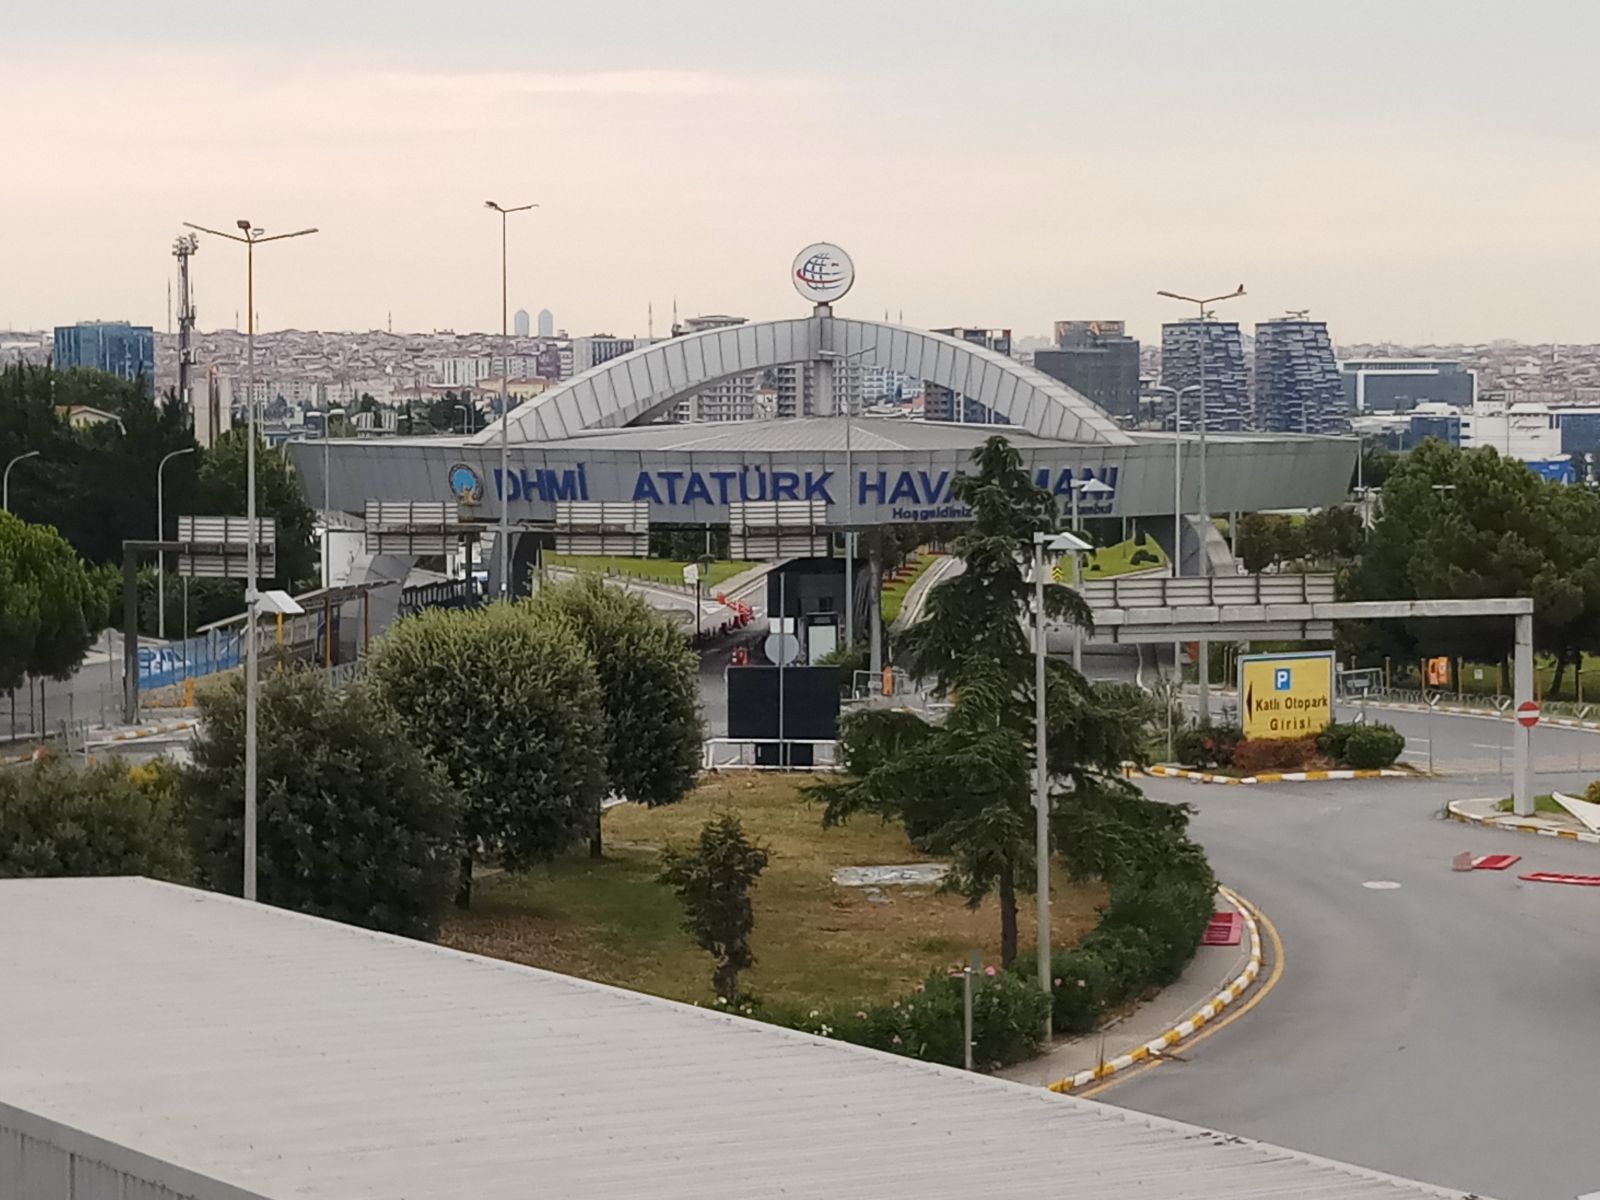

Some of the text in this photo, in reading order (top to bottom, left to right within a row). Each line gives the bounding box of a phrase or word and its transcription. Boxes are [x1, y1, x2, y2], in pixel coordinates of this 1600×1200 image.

[493, 463, 1118, 505] DHMİ ATATÜRK HAVANI
[1277, 670, 1288, 689] P
[1284, 696, 1328, 712] Otopark
